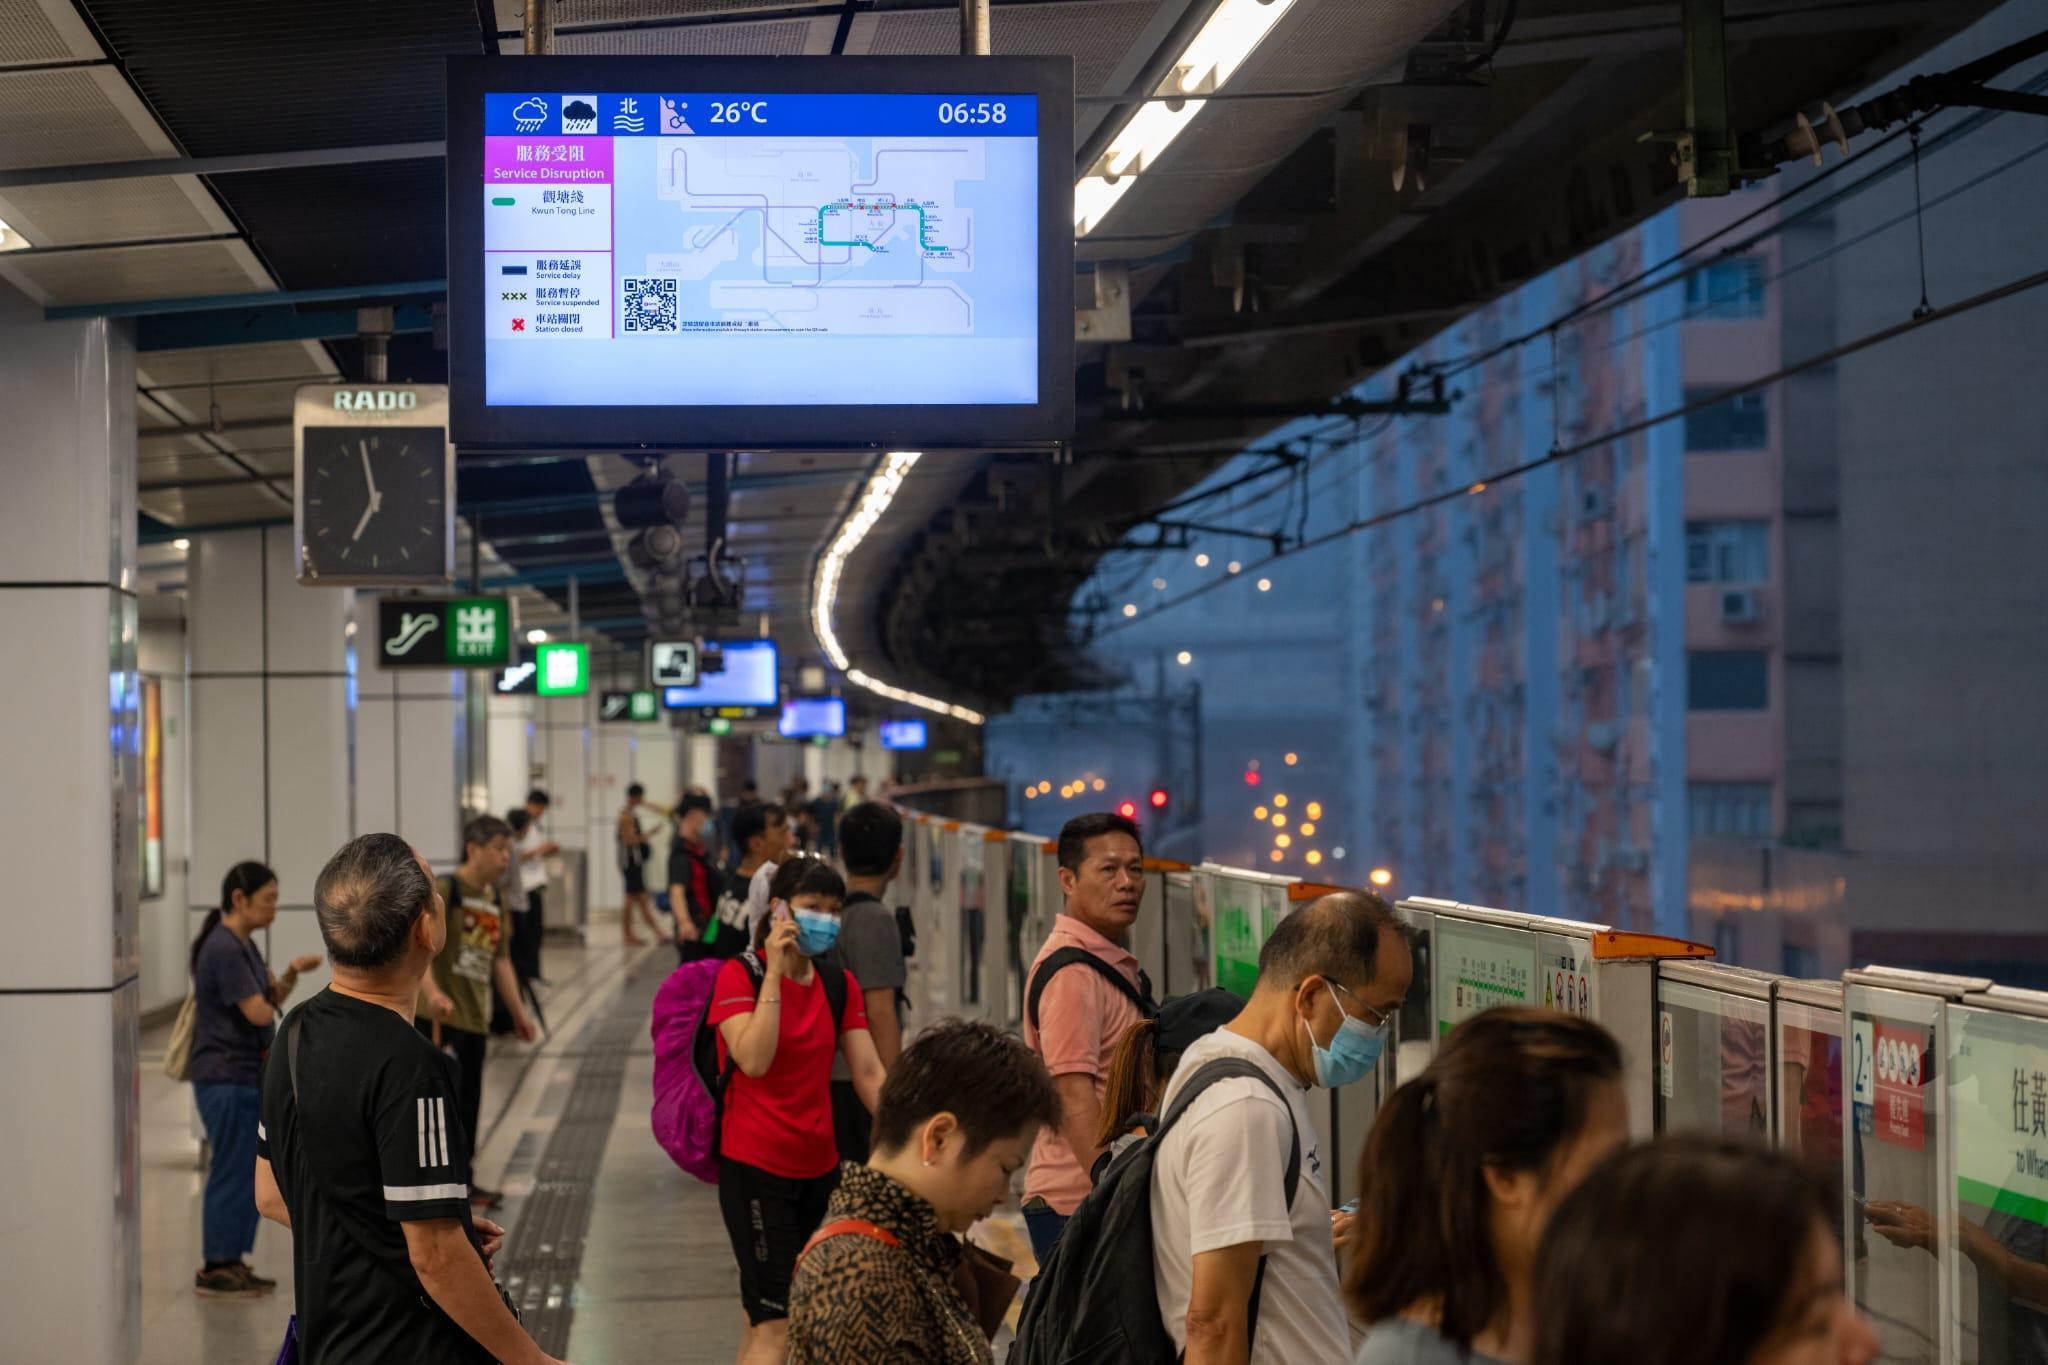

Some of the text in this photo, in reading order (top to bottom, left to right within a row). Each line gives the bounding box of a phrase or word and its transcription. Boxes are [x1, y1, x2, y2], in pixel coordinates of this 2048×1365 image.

[710, 102, 768, 123] 26°C
[938, 102, 1006, 123] 06:58
[516, 144, 585, 162] 服務受阻
[494, 167, 605, 181] Service Disruption
[531, 206, 596, 217] Kwun Tong Line
[537, 259, 582, 271] 服務延誤
[562, 271, 582, 280] delay
[536, 287, 581, 299] 服務暫停
[562, 299, 600, 307] suspended
[536, 313, 581, 325] 車站關閉
[535, 325, 583, 333] Station closed
[333, 390, 417, 410] RADO
[457, 642, 495, 656] EXIT
[2016, 1150, 2025, 1173] to
